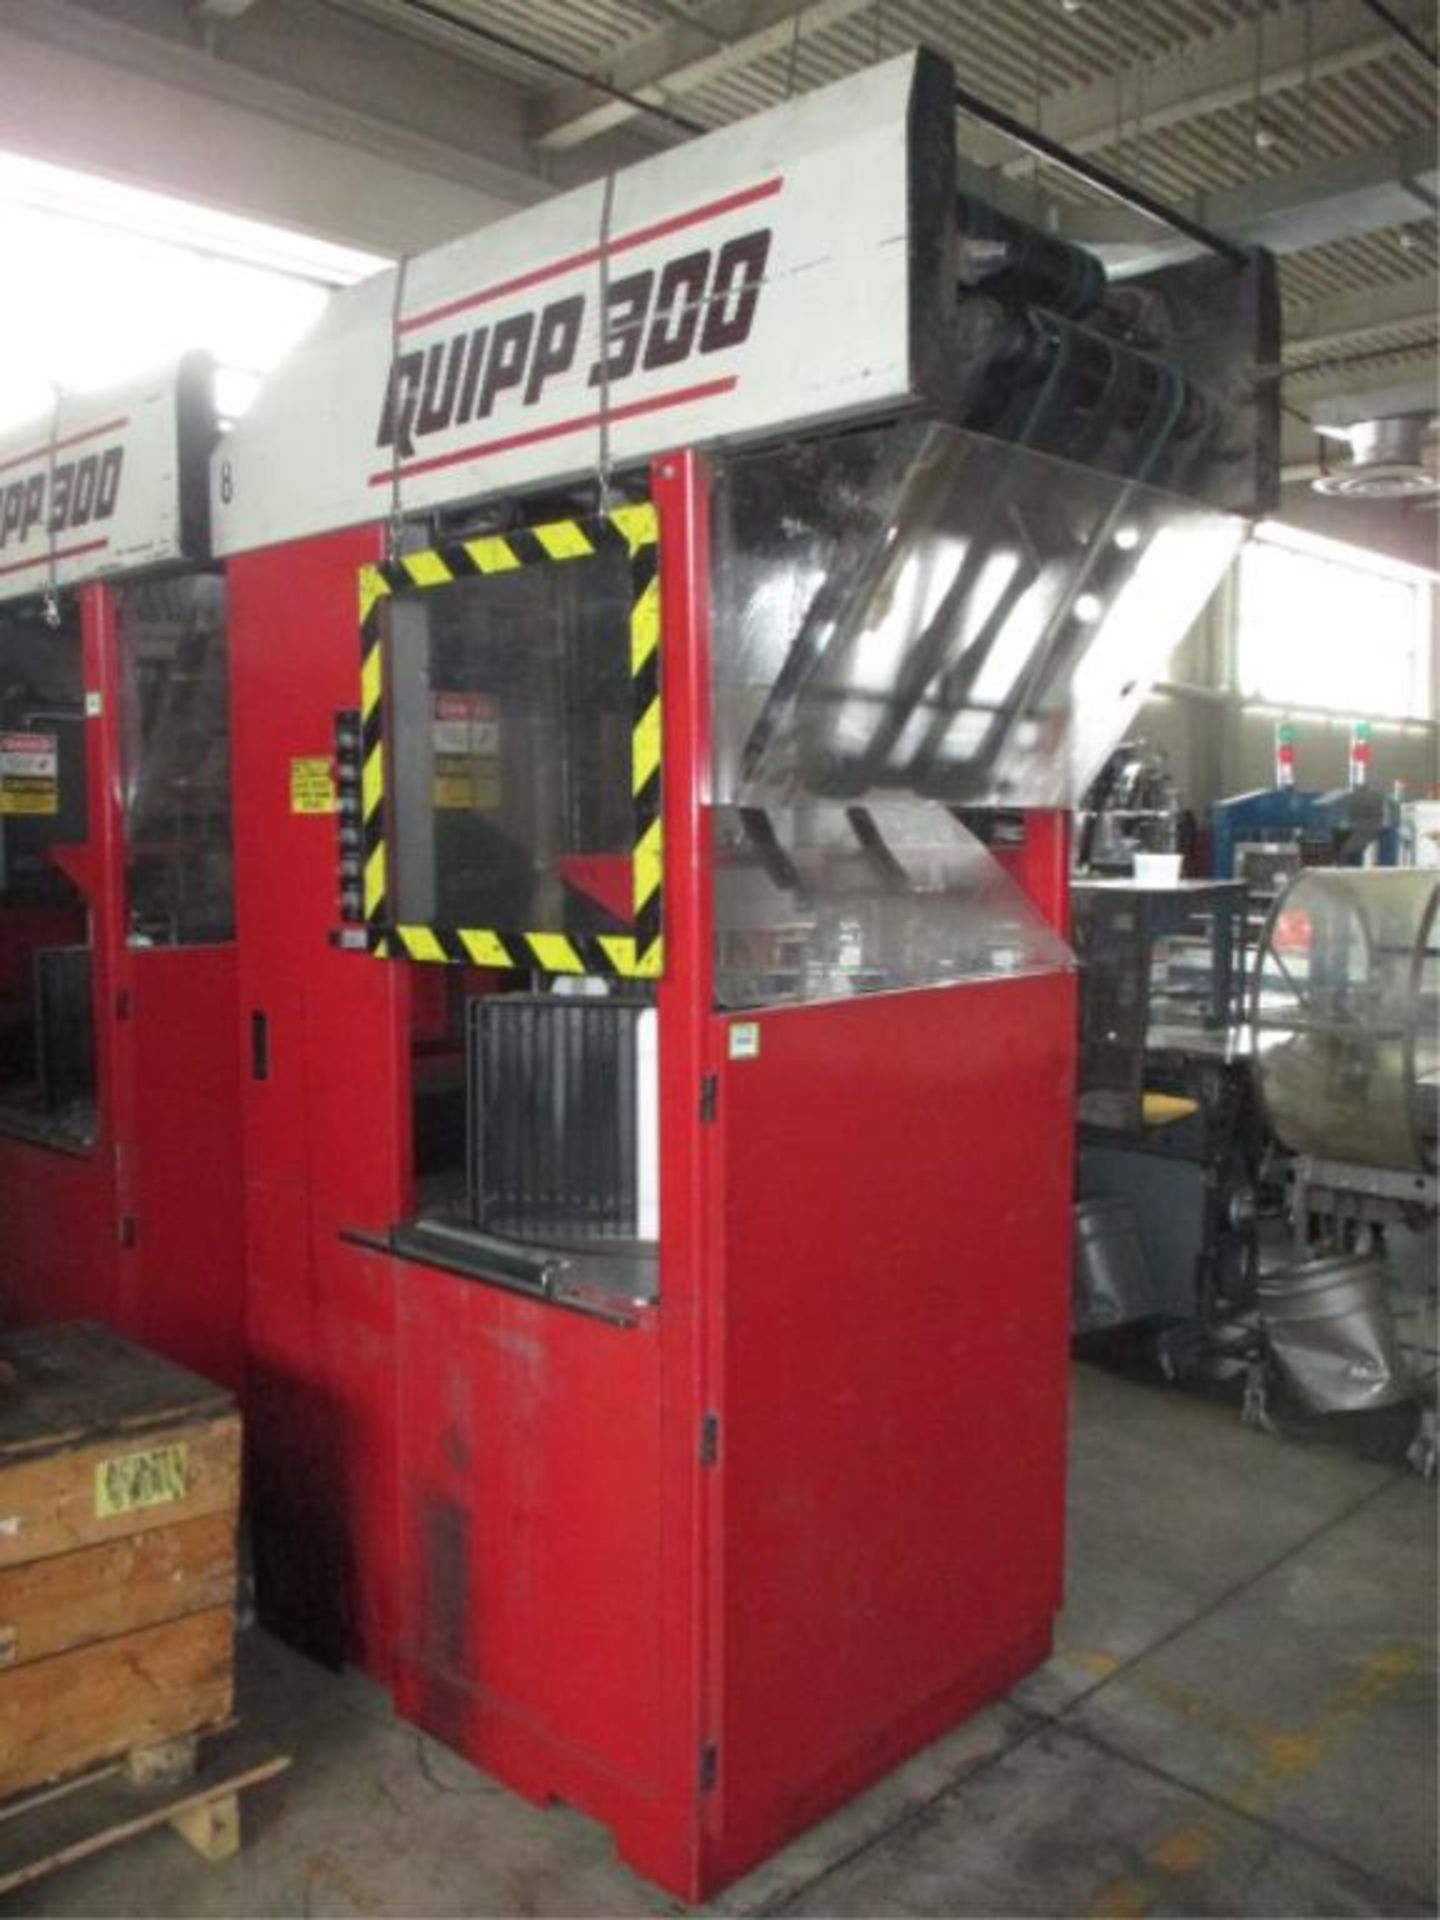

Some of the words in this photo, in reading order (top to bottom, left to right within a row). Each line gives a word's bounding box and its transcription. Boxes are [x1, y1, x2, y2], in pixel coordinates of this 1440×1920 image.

[376, 293, 586, 459] QUIPP
[587, 227, 772, 388] 300
[0, 473, 45, 549] PP
[47, 445, 123, 533] 300
